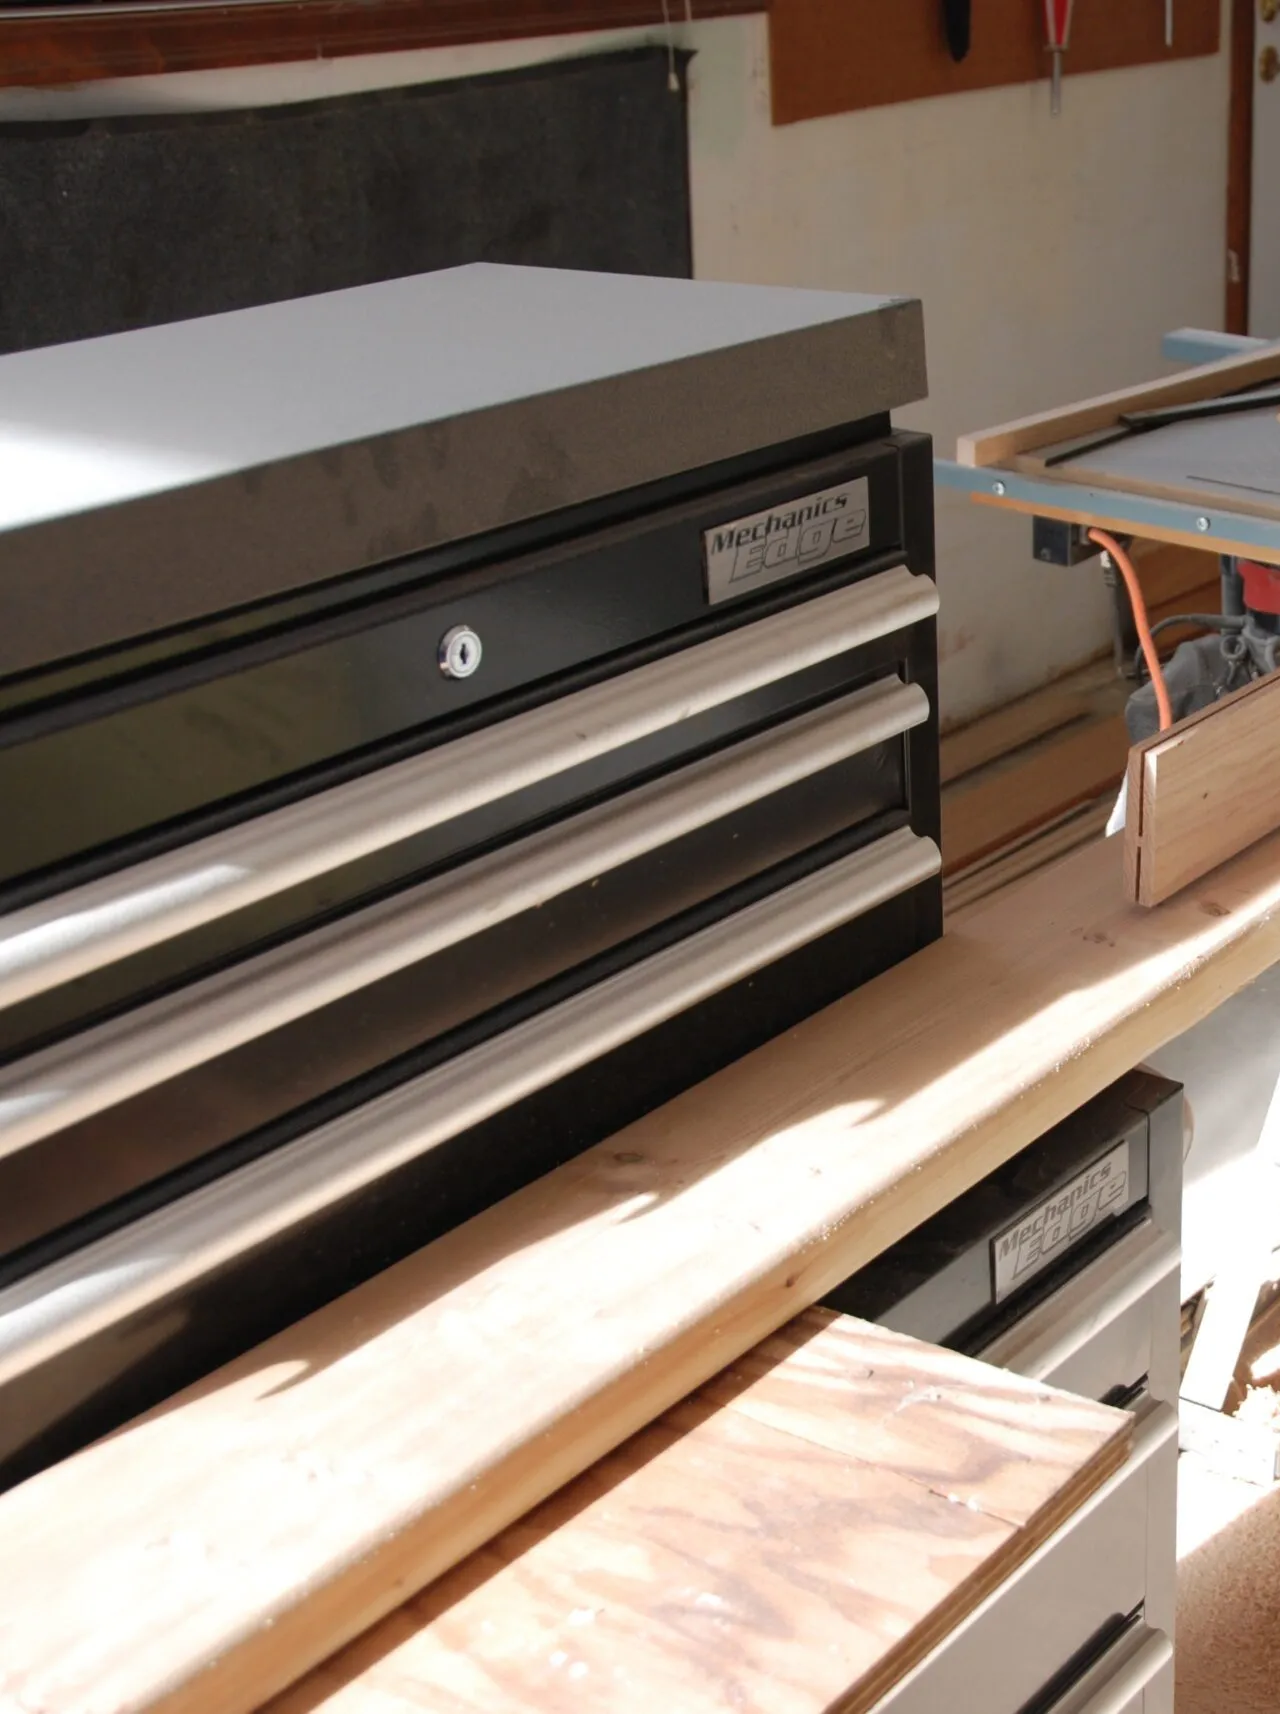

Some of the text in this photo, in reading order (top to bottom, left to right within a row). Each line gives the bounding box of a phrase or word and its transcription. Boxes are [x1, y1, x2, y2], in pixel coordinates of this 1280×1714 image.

[711, 493, 848, 555] Mechanics
[729, 508, 867, 584] Edge
[999, 1161, 1112, 1262] Mechanics
[1012, 1170, 1127, 1281] Edge
